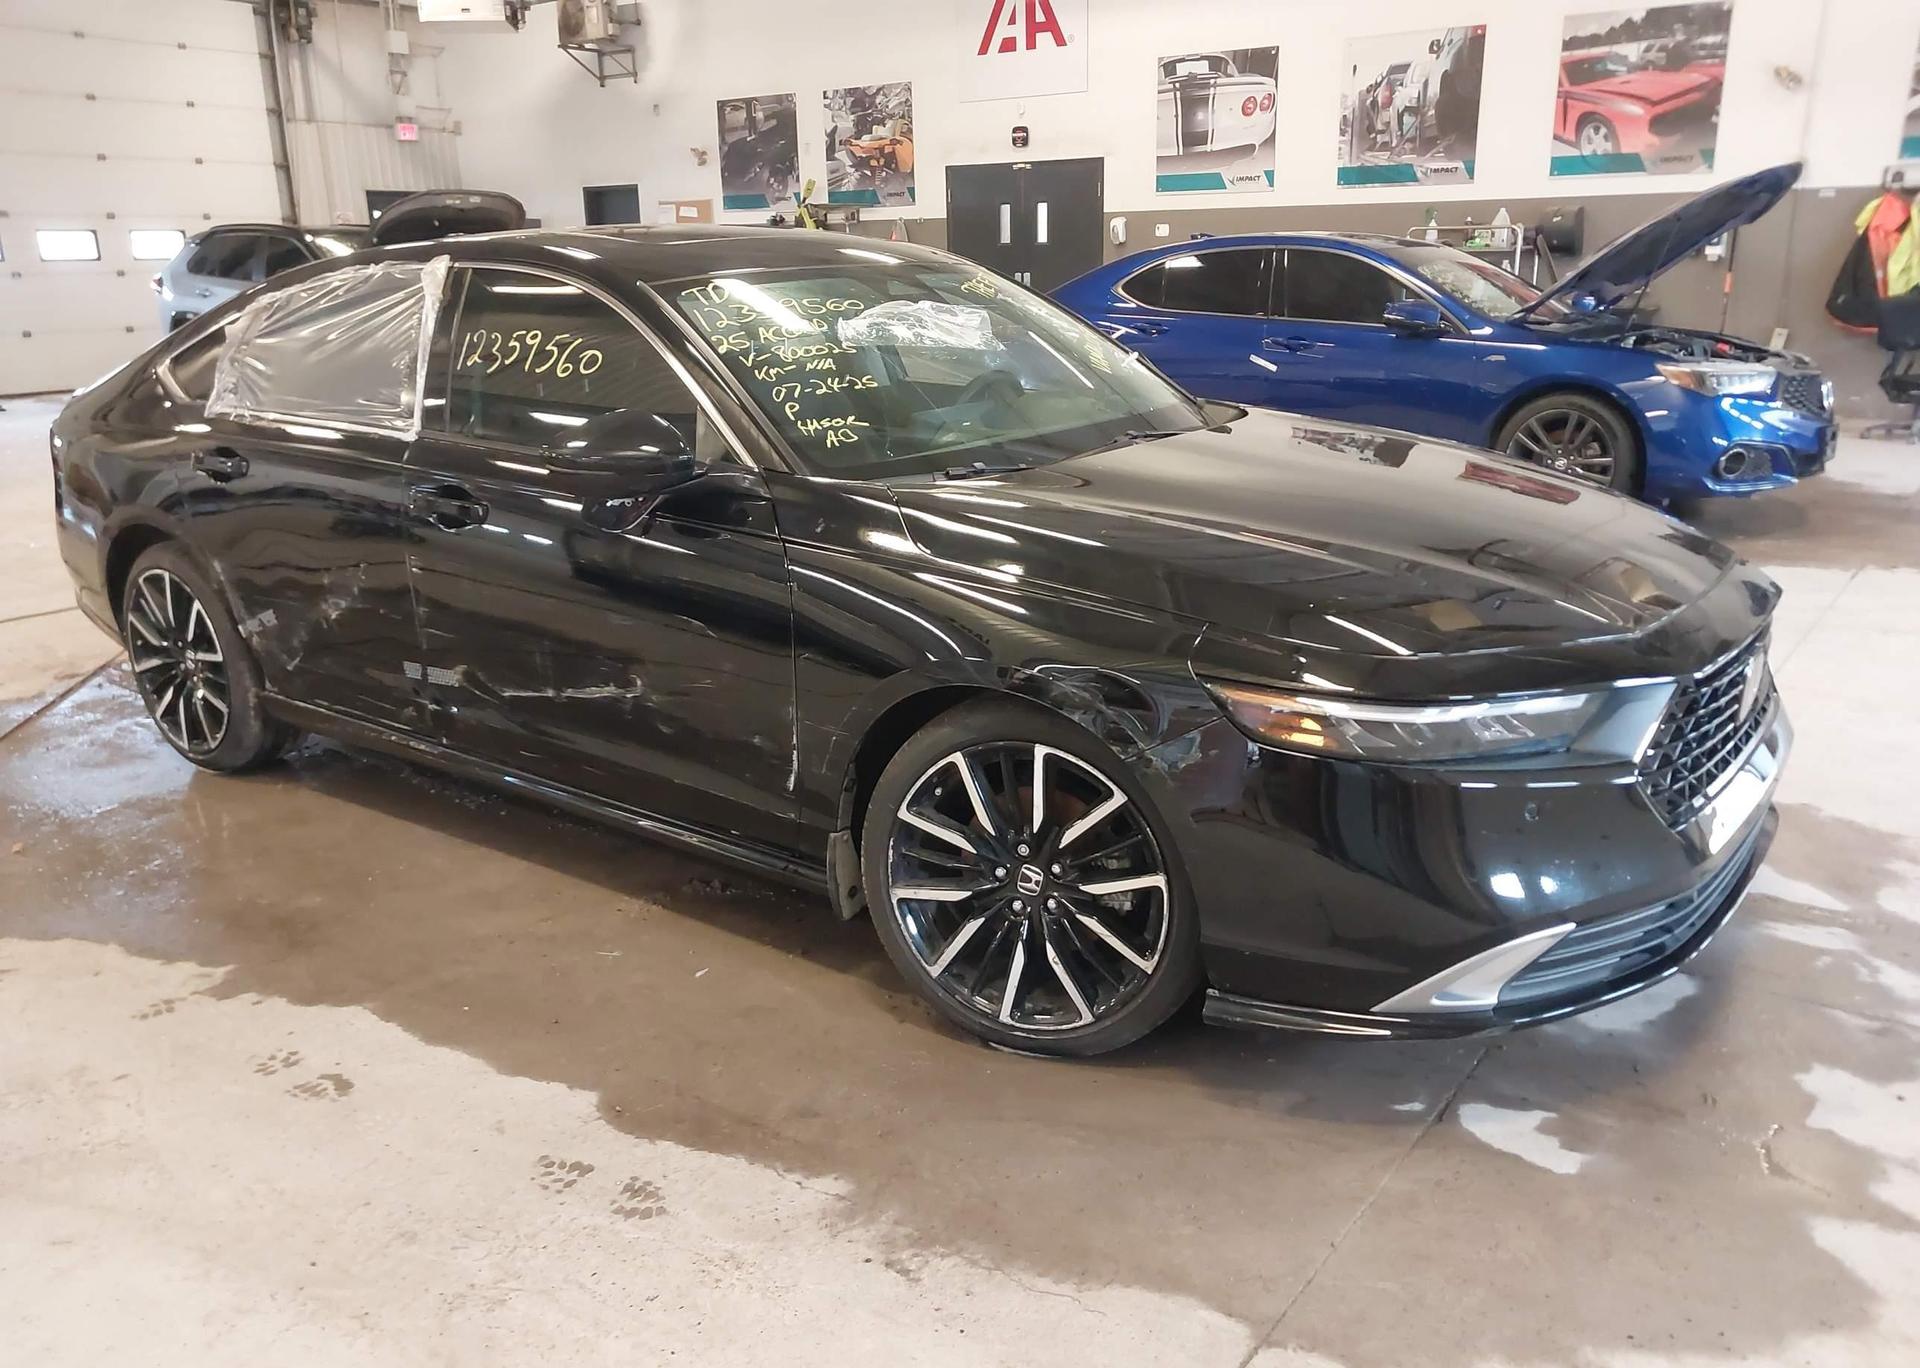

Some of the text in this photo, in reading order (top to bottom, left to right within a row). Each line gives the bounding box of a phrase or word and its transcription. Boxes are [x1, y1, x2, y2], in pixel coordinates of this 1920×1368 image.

[1235, 175, 1262, 183] IMPACT
[1429, 166, 1459, 174] IMPACT
[693, 297, 865, 332] 1239560
[456, 329, 603, 378] 12359560
[772, 374, 879, 402] 07-24-25
[784, 401, 800, 421] P
